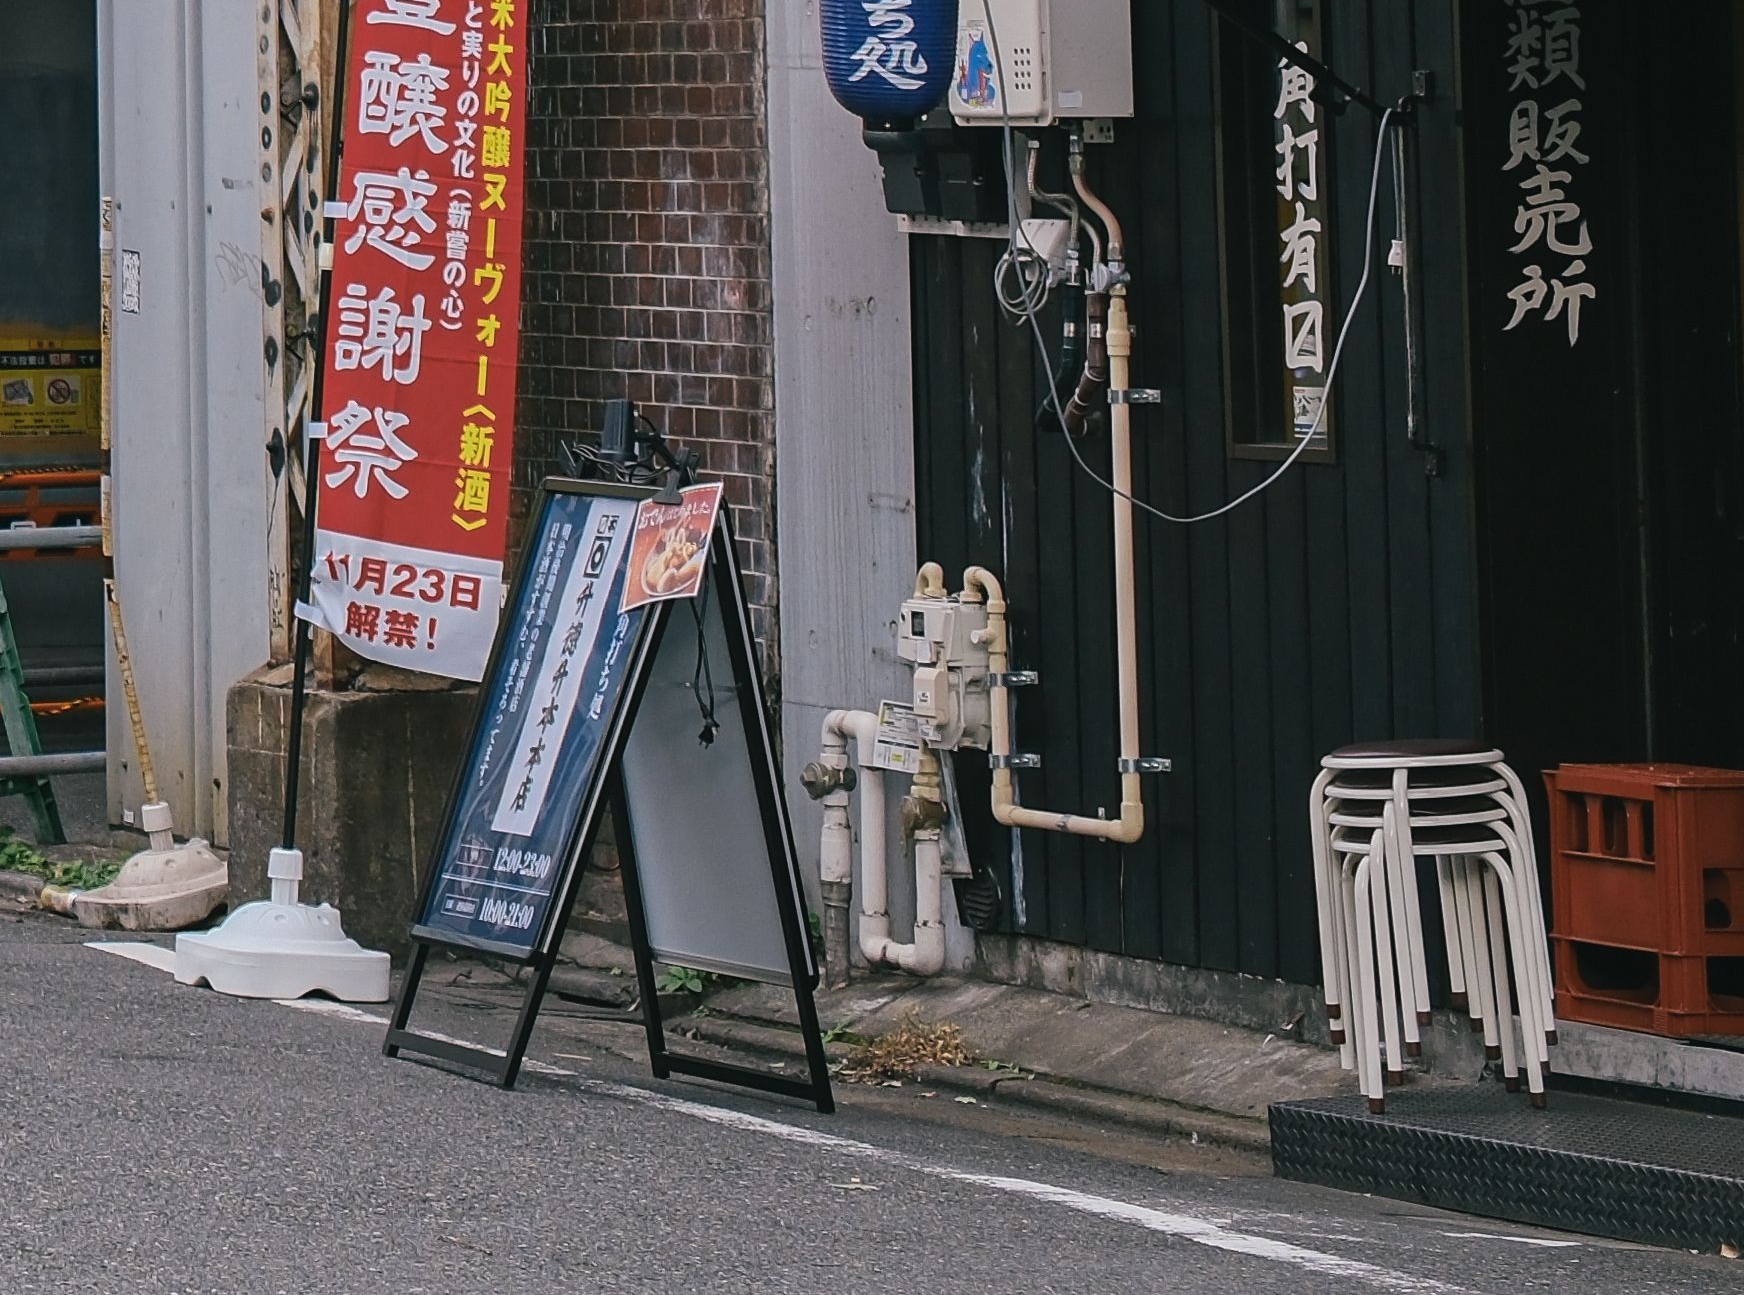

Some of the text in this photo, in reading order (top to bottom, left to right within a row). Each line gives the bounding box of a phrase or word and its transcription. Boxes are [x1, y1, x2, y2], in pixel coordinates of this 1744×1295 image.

[323, 552, 484, 611] 11月23日
[345, 601, 438, 653] 解禁!
[493, 847, 552, 880] 12:00-23:00
[478, 897, 535, 930] 10:00-21:00
